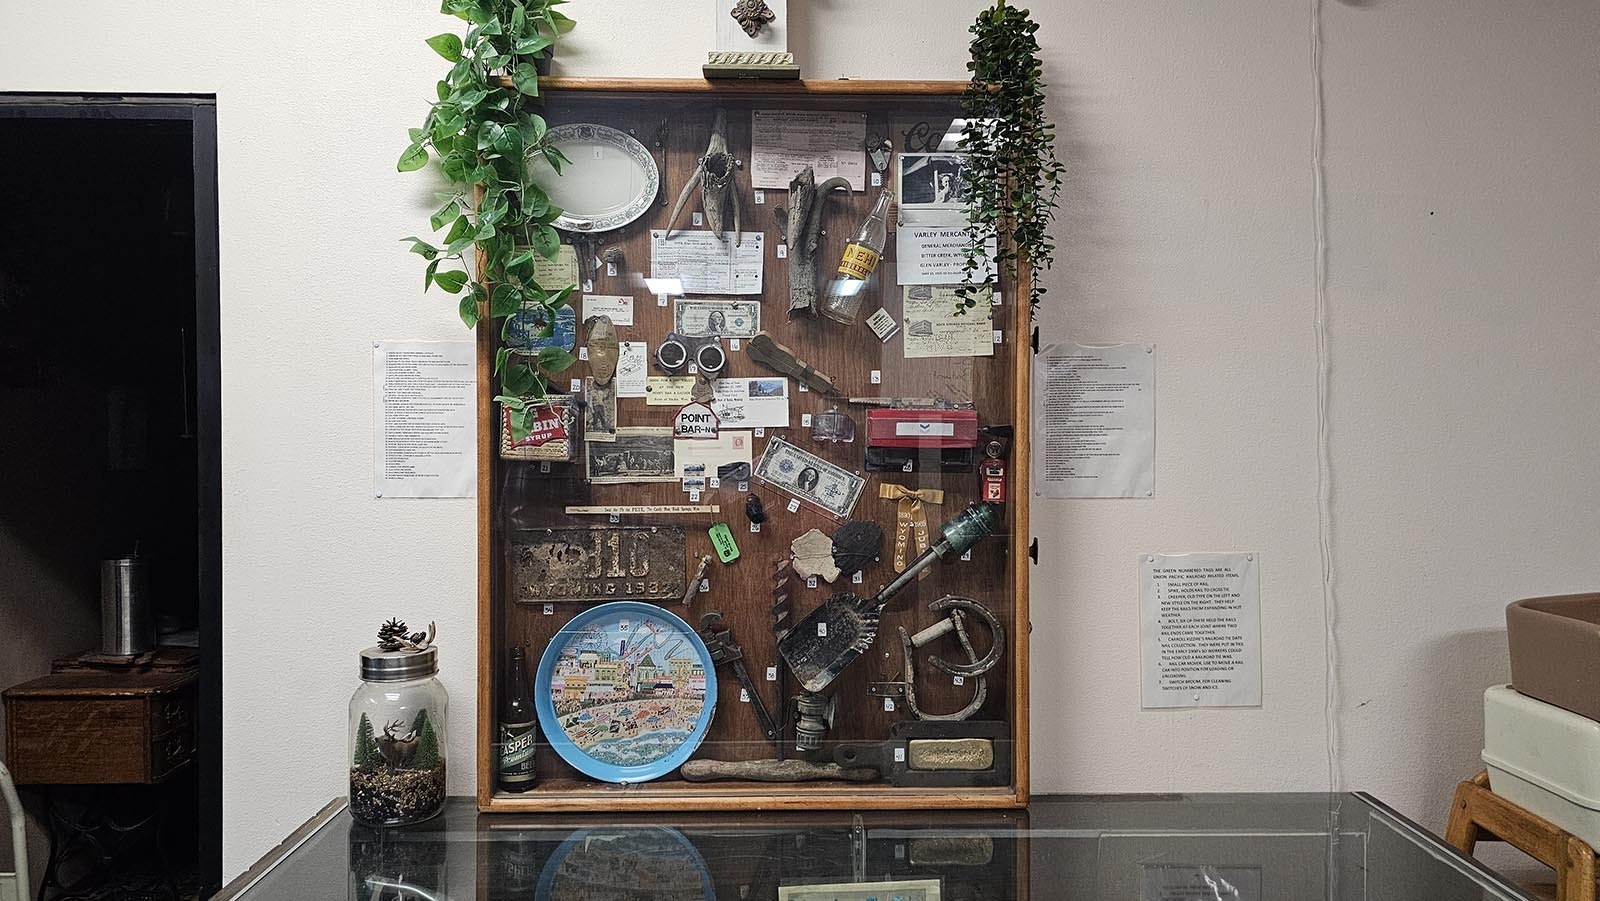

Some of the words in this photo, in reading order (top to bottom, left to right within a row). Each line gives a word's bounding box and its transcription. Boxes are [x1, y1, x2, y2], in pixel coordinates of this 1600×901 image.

[847, 248, 876, 267] NEHI
[681, 414, 711, 423] POINT
[531, 418, 560, 432] BIN
[681, 425, 710, 433] BAR-N
[525, 432, 552, 442] SYRUP
[897, 522, 908, 566] WYOMING
[528, 584, 616, 596] WYOMING
